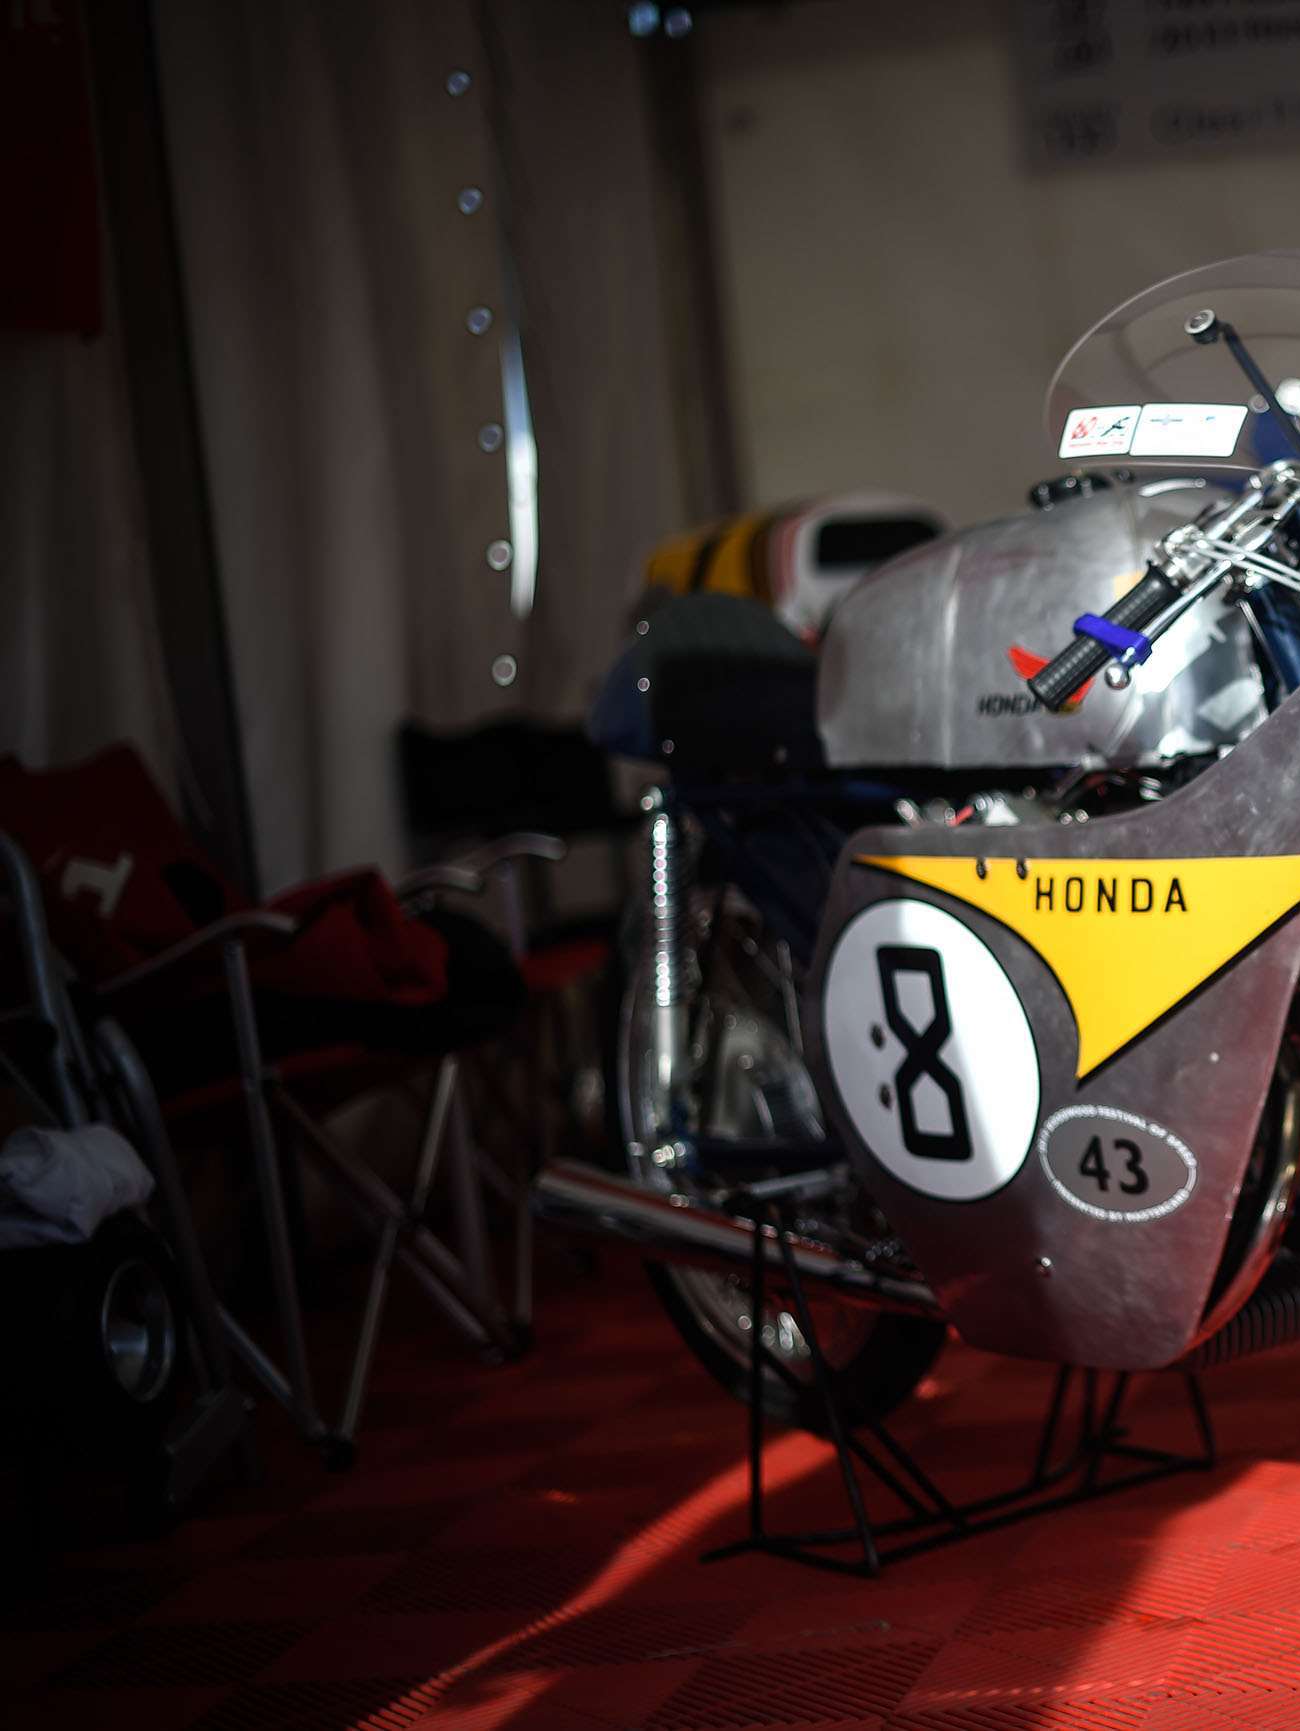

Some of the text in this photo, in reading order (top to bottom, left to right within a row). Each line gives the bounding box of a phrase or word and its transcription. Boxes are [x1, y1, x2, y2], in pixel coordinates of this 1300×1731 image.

[1034, 877, 1188, 913] HONDA
[876, 945, 974, 1161] 8
[1079, 1133, 1150, 1196] 43
